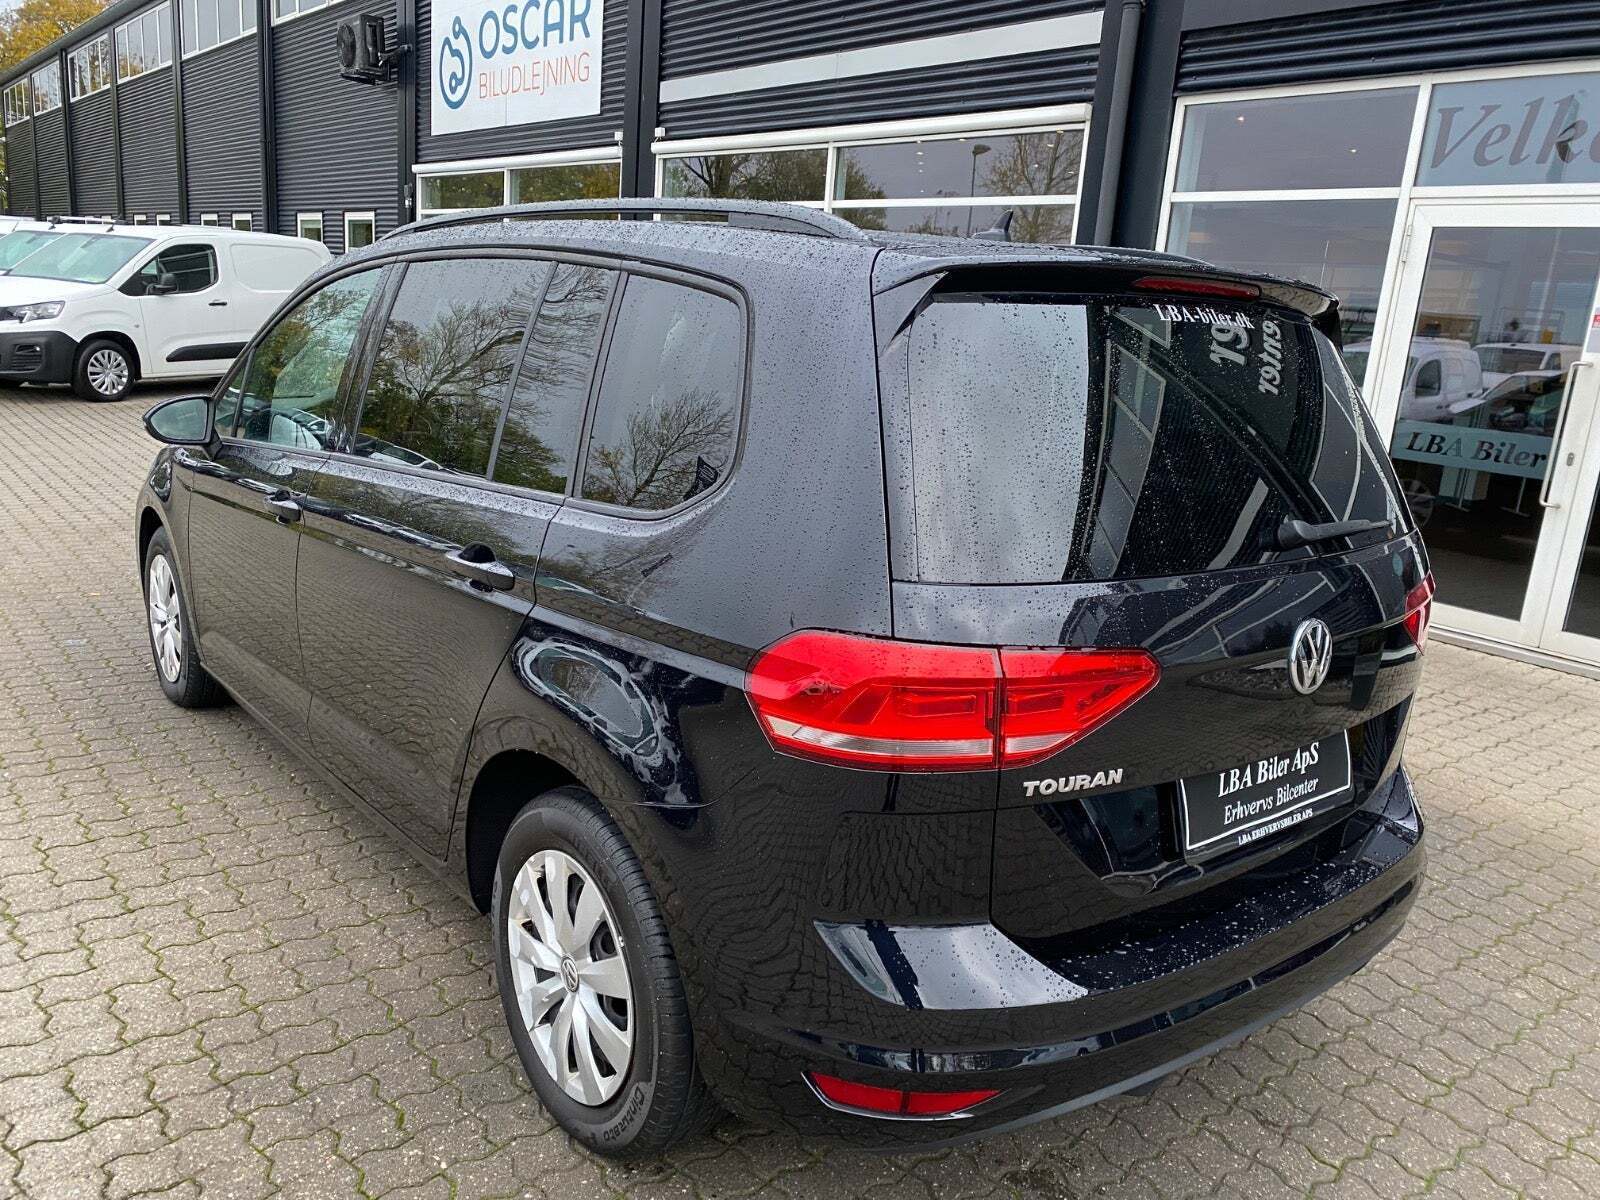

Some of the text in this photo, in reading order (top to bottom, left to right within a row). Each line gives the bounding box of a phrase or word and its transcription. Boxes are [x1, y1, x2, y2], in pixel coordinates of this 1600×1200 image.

[478, 0, 591, 59] OSCAR
[479, 52, 590, 99] BILUDLEJNING
[1153, 303, 1256, 329] LBA-biler.dk
[1406, 431, 1547, 468] LBA Biler
[1023, 768, 1124, 797] TOURAN
[1218, 742, 1319, 797] LBA Biler ApS
[1223, 777, 1318, 825] Erhvervs Bilcenter
